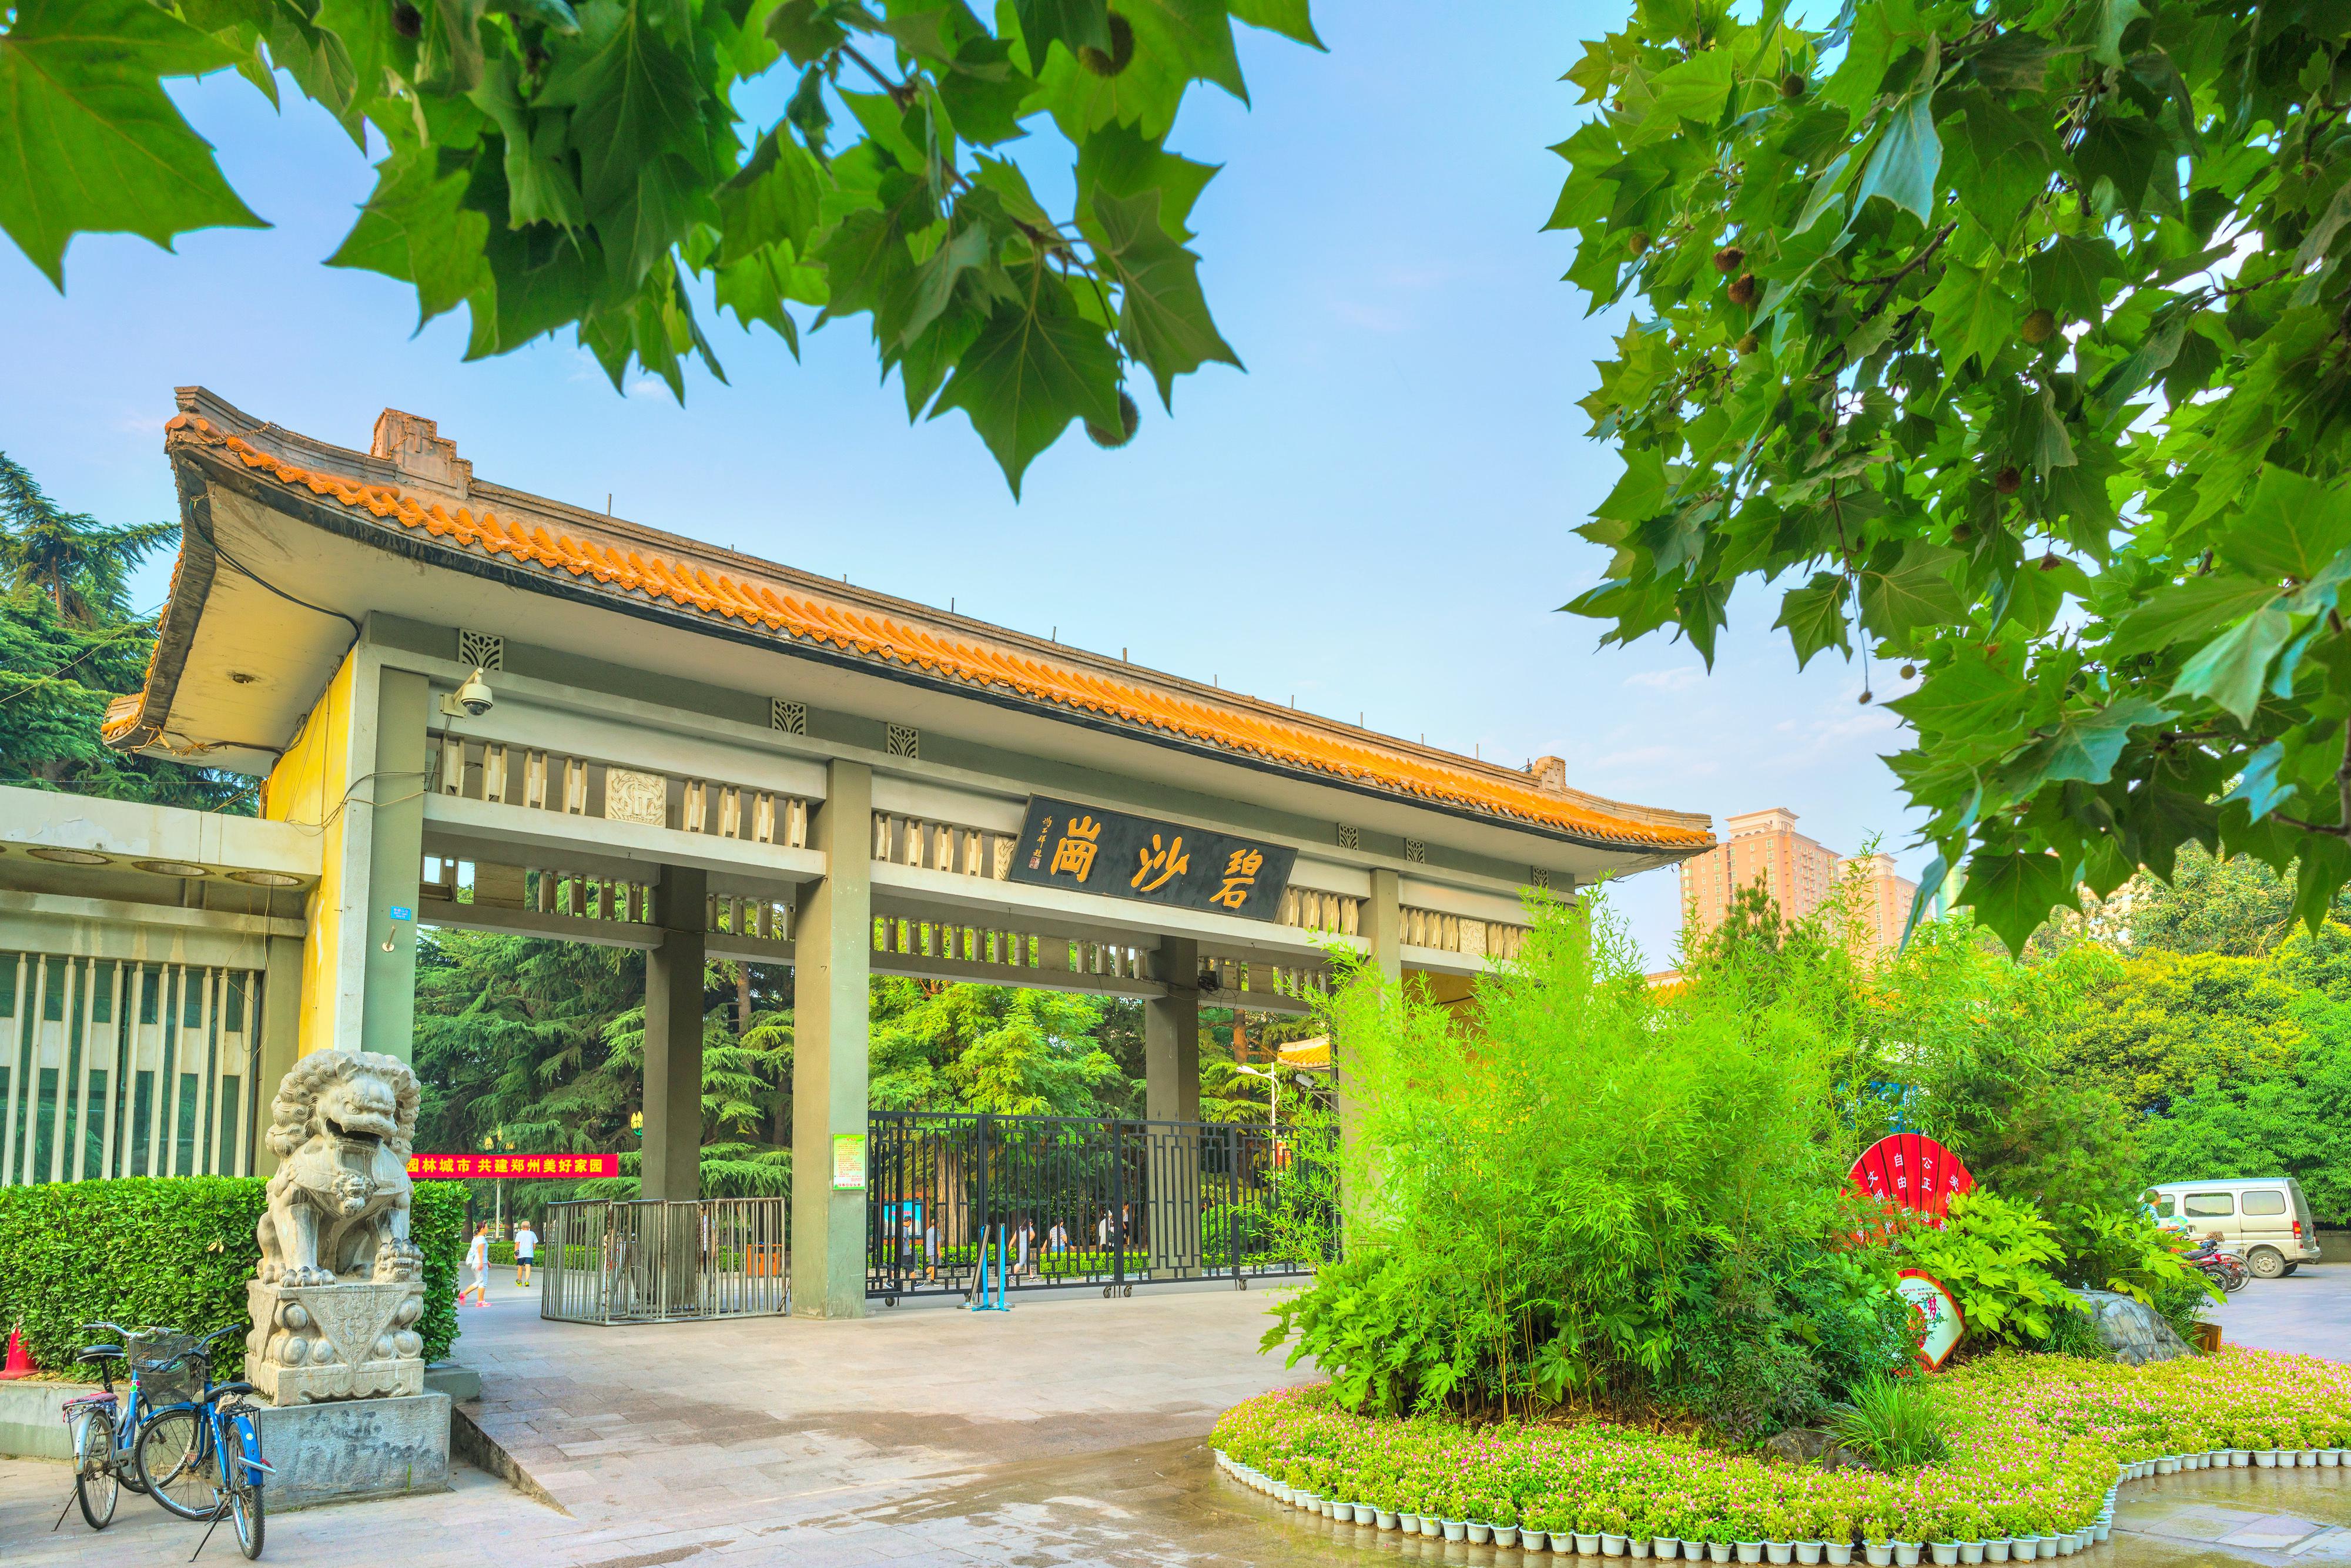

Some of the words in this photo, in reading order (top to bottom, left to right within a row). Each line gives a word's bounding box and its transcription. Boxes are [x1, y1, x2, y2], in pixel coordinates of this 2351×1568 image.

[477, 1158, 603, 1173] 共建郑州美好家园
[1894, 1152, 1907, 1190] 自由
[1921, 1157, 1933, 1192] 公正
[1867, 1170, 1885, 1204] 文明
